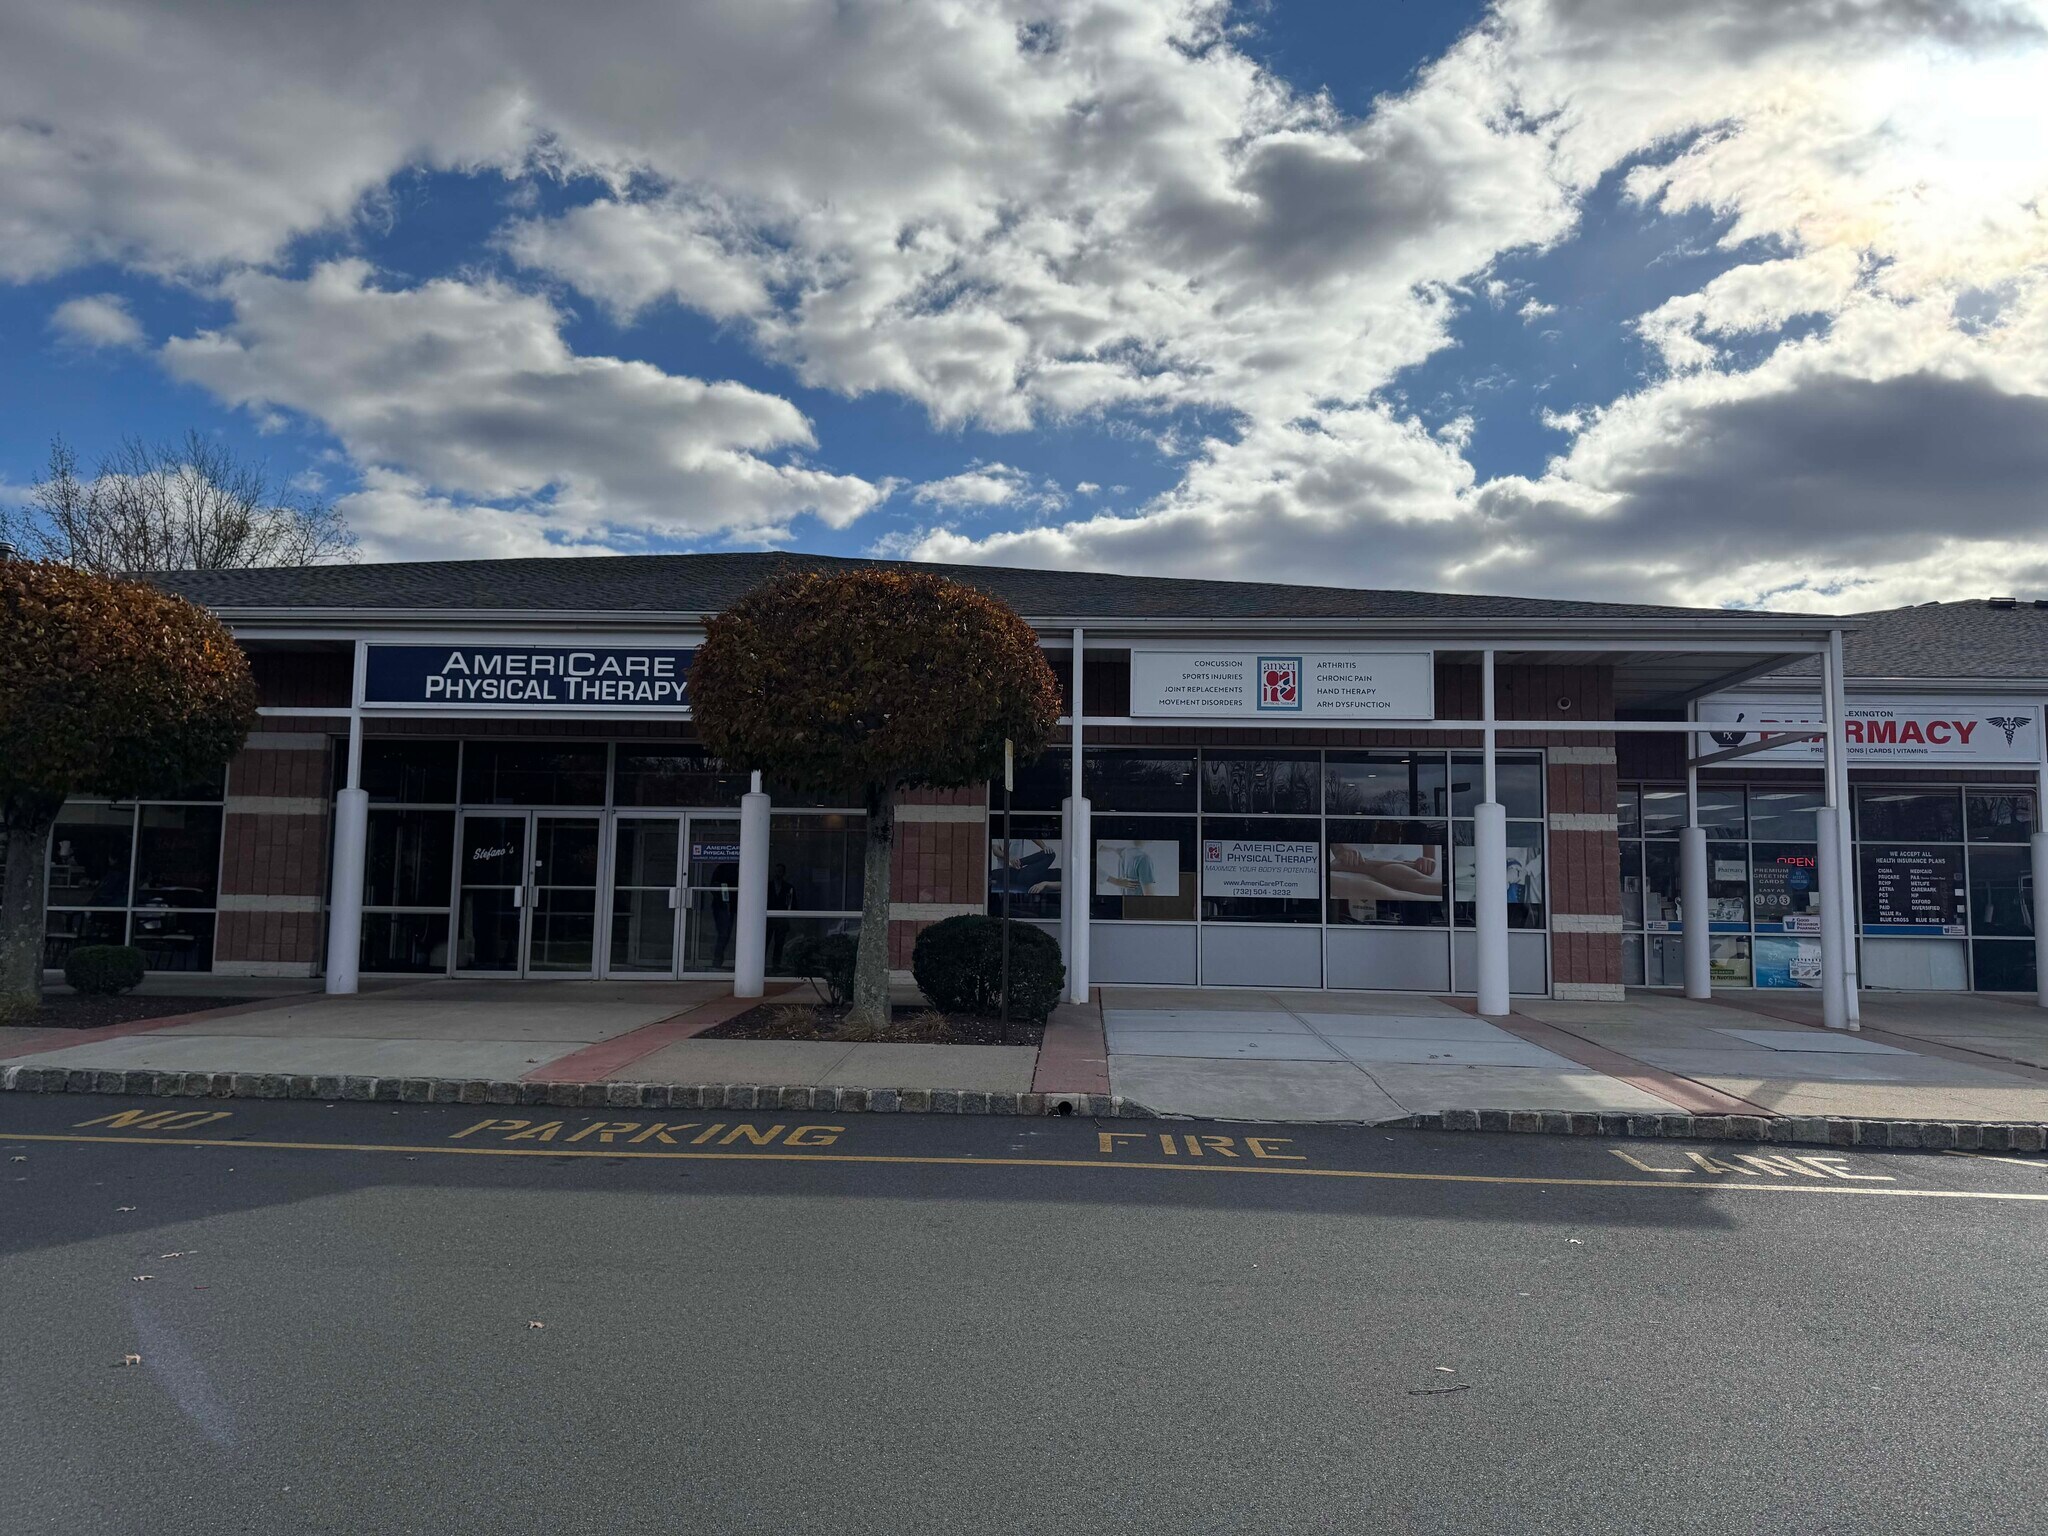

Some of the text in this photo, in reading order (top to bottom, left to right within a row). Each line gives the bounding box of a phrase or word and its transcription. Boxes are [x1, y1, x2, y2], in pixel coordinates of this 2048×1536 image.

[441, 651, 675, 677] AMERICARE
[1263, 661, 1296, 670] ameri
[425, 675, 687, 701] PHYSICAL THERAPY
[473, 842, 514, 860] Stefano's
[1233, 843, 1313, 853] AMERICARE
[1227, 853, 1318, 863] PHYSICAL THERAPY
[1776, 857, 1814, 867] OPEN
[71, 1109, 1896, 1181] NO PARKING FIRE LANE
